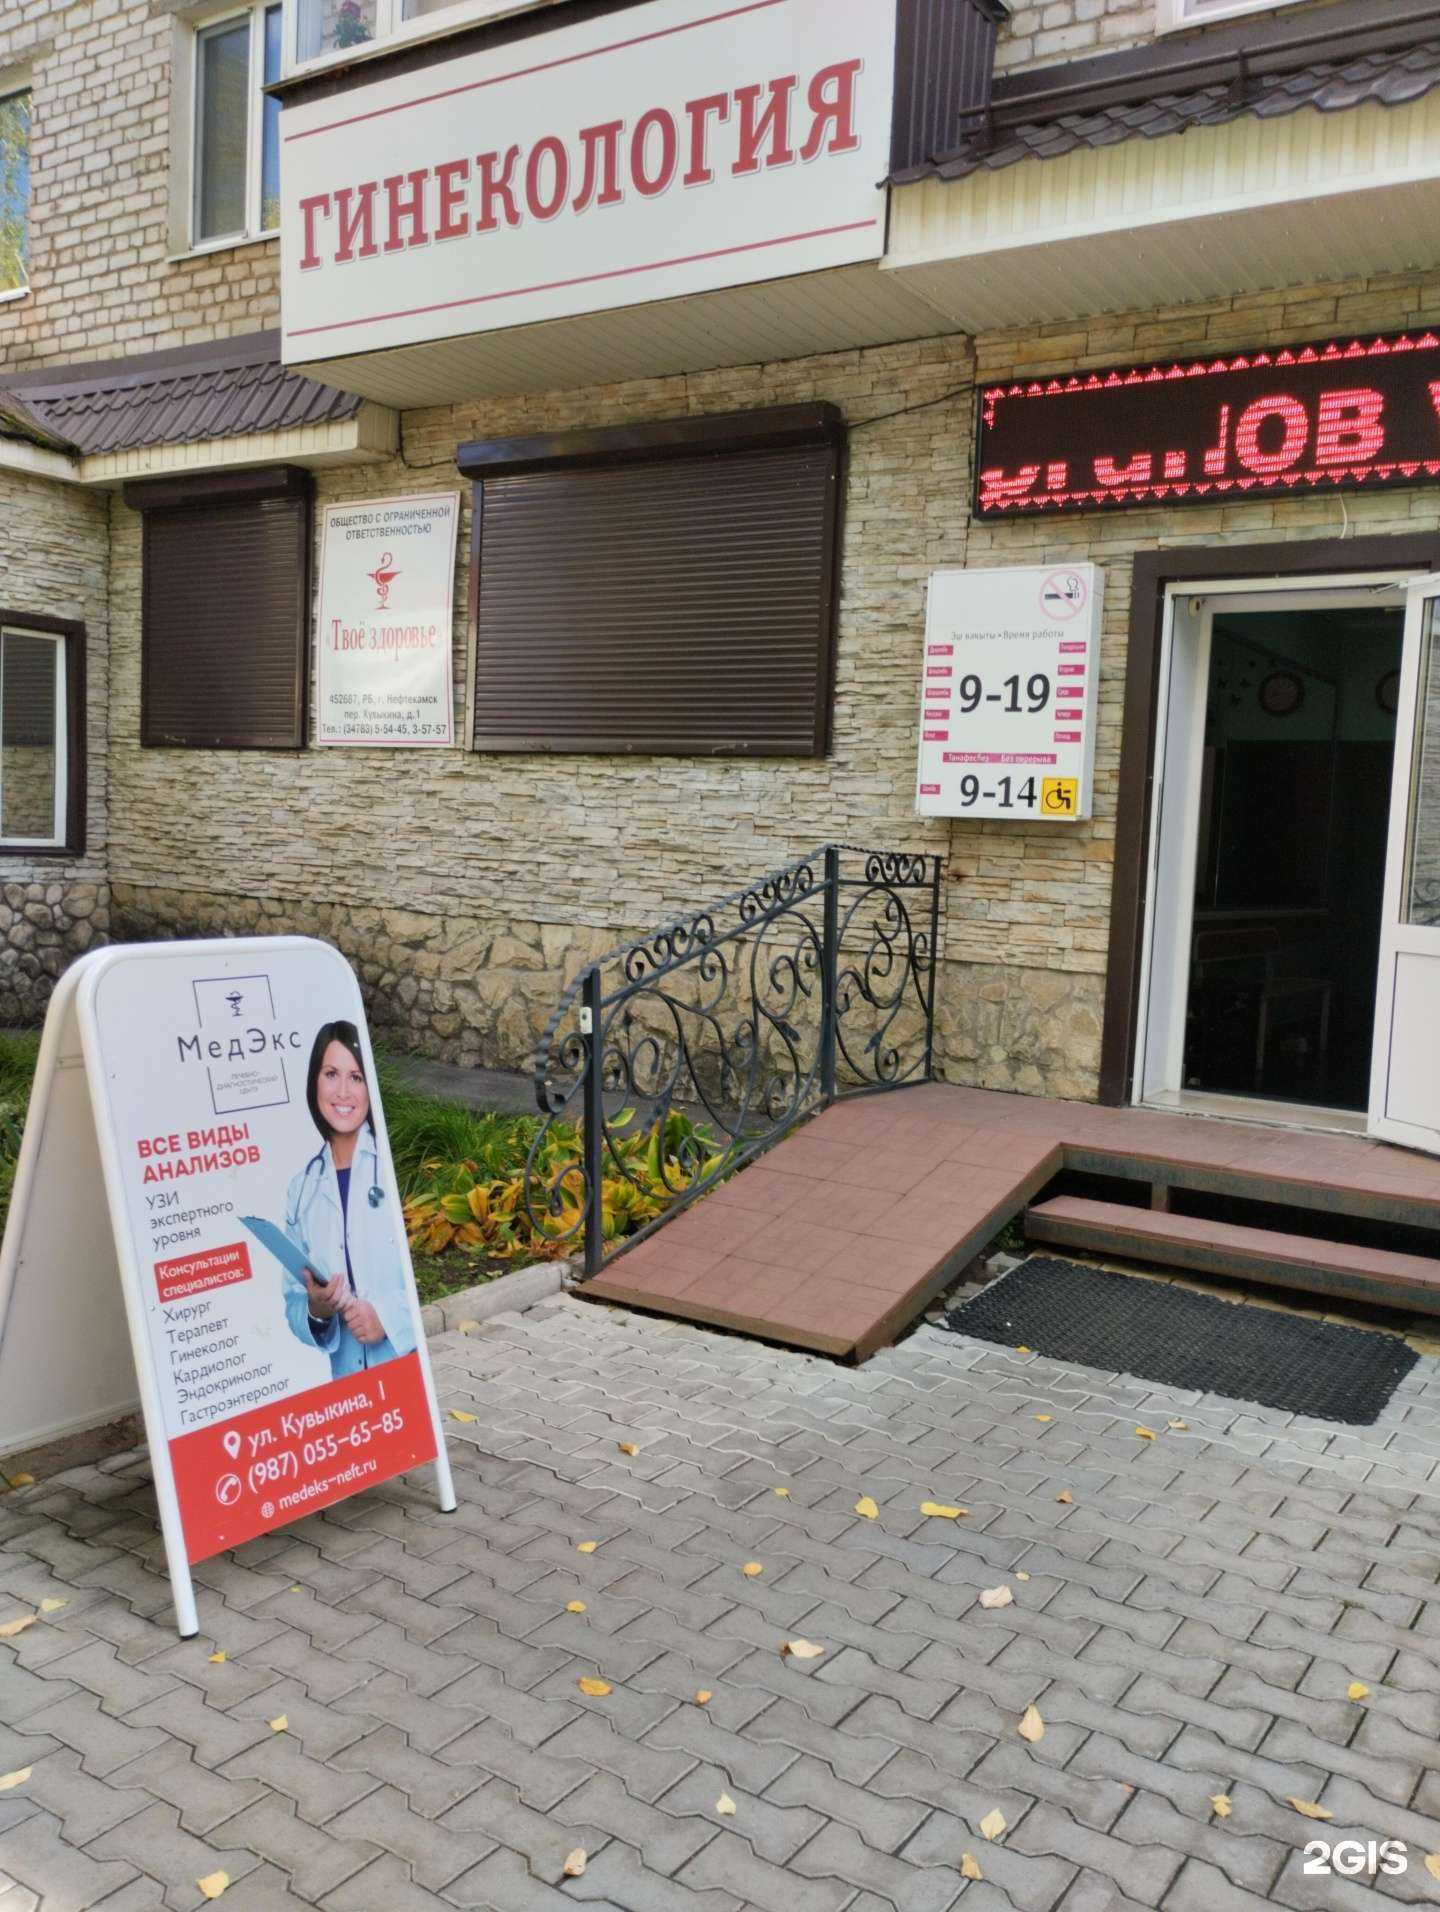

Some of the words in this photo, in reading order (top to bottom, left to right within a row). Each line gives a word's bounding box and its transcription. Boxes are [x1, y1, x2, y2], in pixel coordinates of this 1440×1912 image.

[300, 58, 863, 270] ГИНЕКОЛОГИЯ
[330, 513, 374, 528] ОБЩЕСТВО
[375, 512, 383, 523] С
[384, 506, 450, 523] ОГРАНИЧЕННОЙ
[345, 523, 432, 541] ОТВЕТСТВЕННОСТЬЮ
[332, 619, 366, 651] Твоё
[369, 622, 437, 661] здоровье
[1003, 630, 1030, 641] Время
[1032, 629, 1065, 641] работы
[387, 694, 438, 706] Нефтекамск
[959, 673, 1051, 714] 9-19
[960, 774, 1037, 808] 9-14
[177, 1028, 302, 1062] МедЭкс
[137, 1134, 182, 1158] ВСЕ
[187, 1122, 250, 1149] ВИДЫ
[143, 1145, 261, 1185] АНАЛИЗОВ
[145, 1190, 180, 1211] УЗИ
[150, 1201, 234, 1229] экспертного
[152, 1227, 201, 1252] уровня
[159, 1250, 241, 1280] Консультации
[163, 1267, 245, 1298] специалистов:
[163, 1301, 213, 1325] Хирург
[166, 1317, 229, 1345] Терапевт
[170, 1335, 240, 1366] Гинеколог
[173, 1352, 247, 1385] Кардиолог
[176, 1363, 273, 1404] Эндокринолог
[180, 1378, 290, 1425] Гастроэнтеролог
[248, 1428, 278, 1458] ул.
[281, 1393, 373, 1439] Кувыкина,
[248, 1451, 299, 1494] (987)
[304, 1408, 404, 1465] 055-65-85
[278, 1458, 378, 1510] medeks-neft.ru
